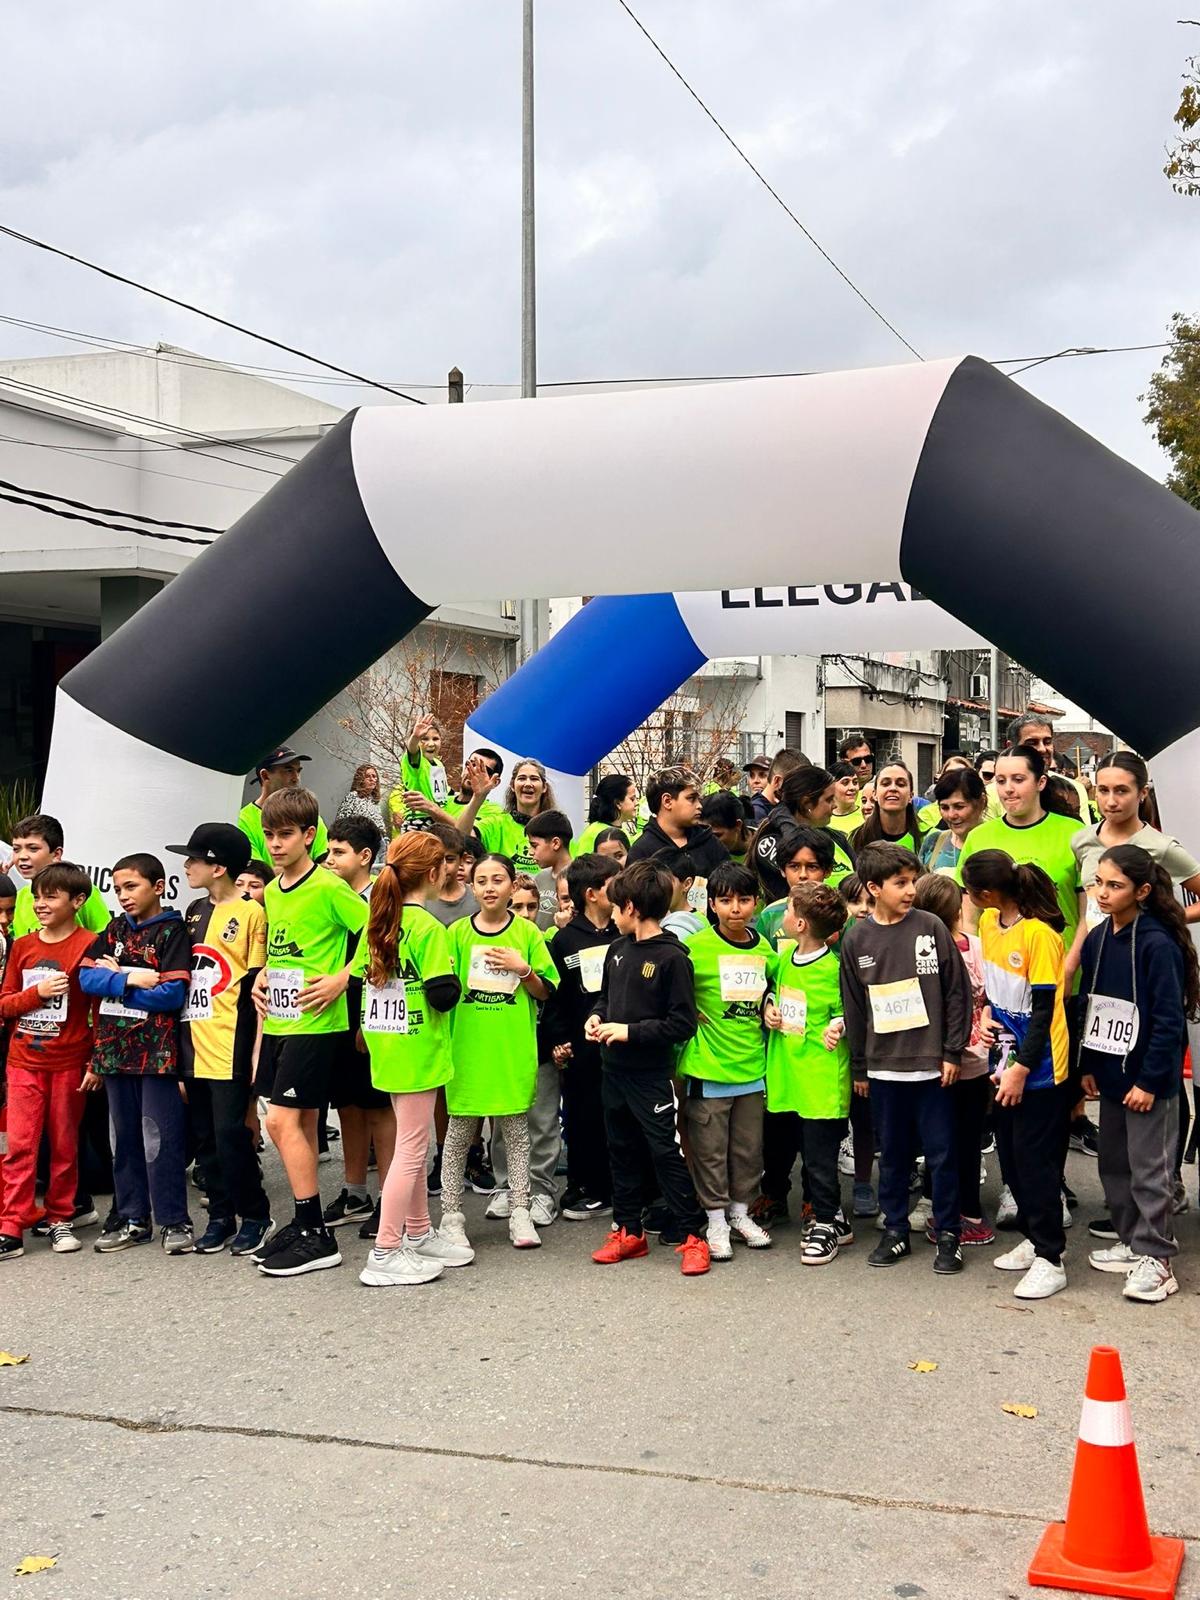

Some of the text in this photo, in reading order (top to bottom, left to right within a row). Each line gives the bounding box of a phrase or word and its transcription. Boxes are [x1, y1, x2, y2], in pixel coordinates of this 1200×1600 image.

[916, 960, 938, 968] CREW
[917, 967, 940, 975] CREW
[734, 971, 758, 985] 377
[273, 988, 299, 1009] 053
[474, 992, 505, 1003] ARTIGAS
[369, 998, 378, 1020] A
[383, 999, 406, 1021] 119
[780, 1003, 796, 1019] 03
[884, 999, 910, 1016] 467
[1089, 1015, 1134, 1043] A 109
